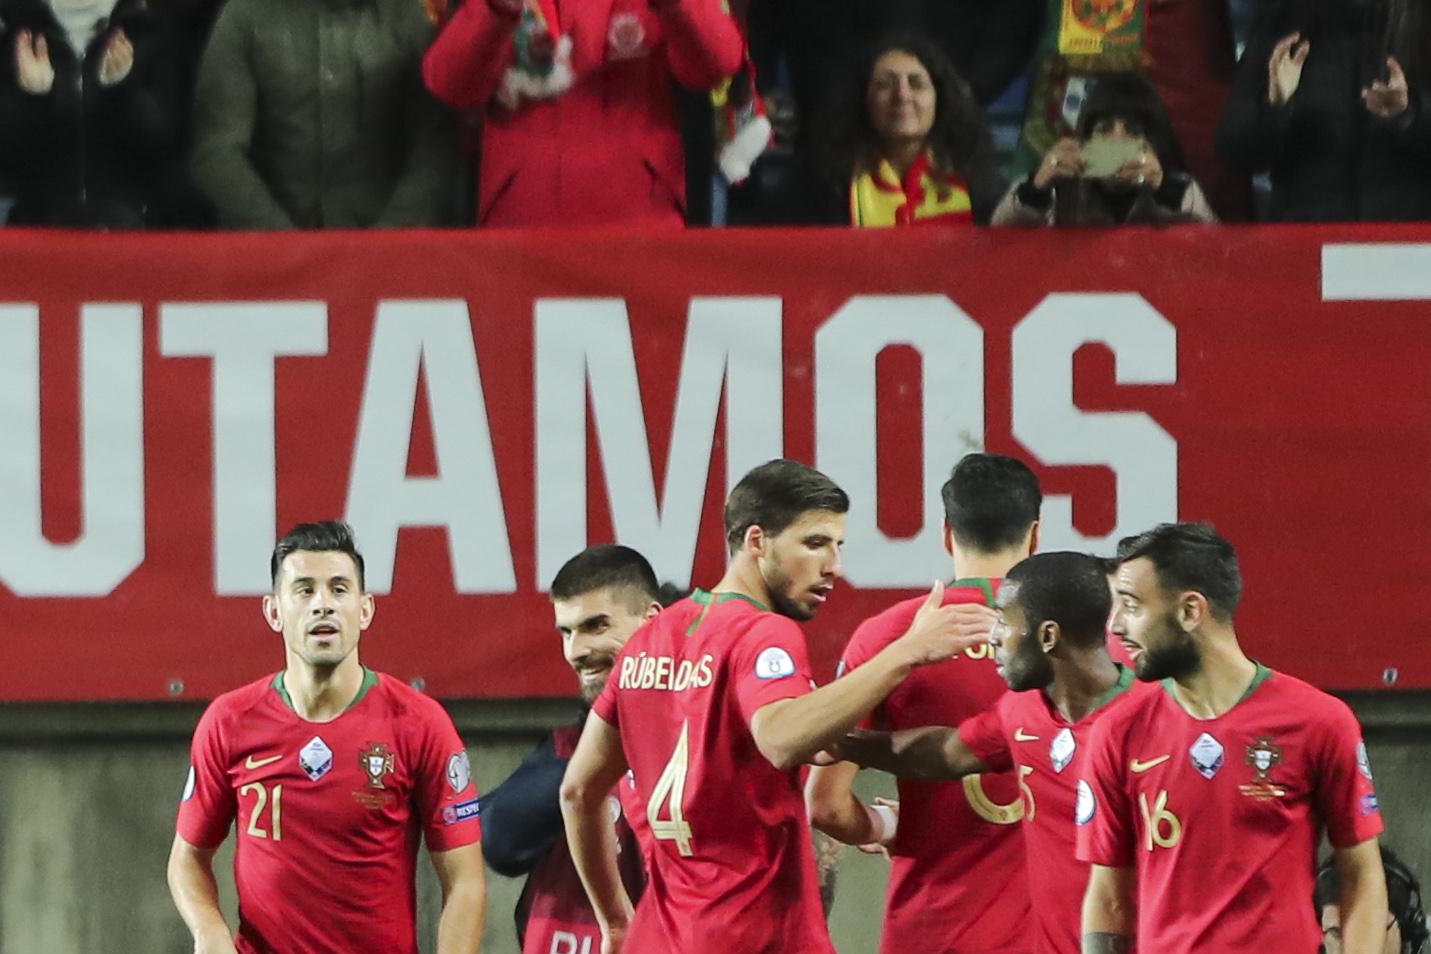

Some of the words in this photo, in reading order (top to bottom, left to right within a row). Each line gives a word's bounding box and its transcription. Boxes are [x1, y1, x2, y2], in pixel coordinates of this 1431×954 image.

[240, 781, 283, 842] 21
[647, 717, 694, 857] 4
[1139, 789, 1182, 852] 16
